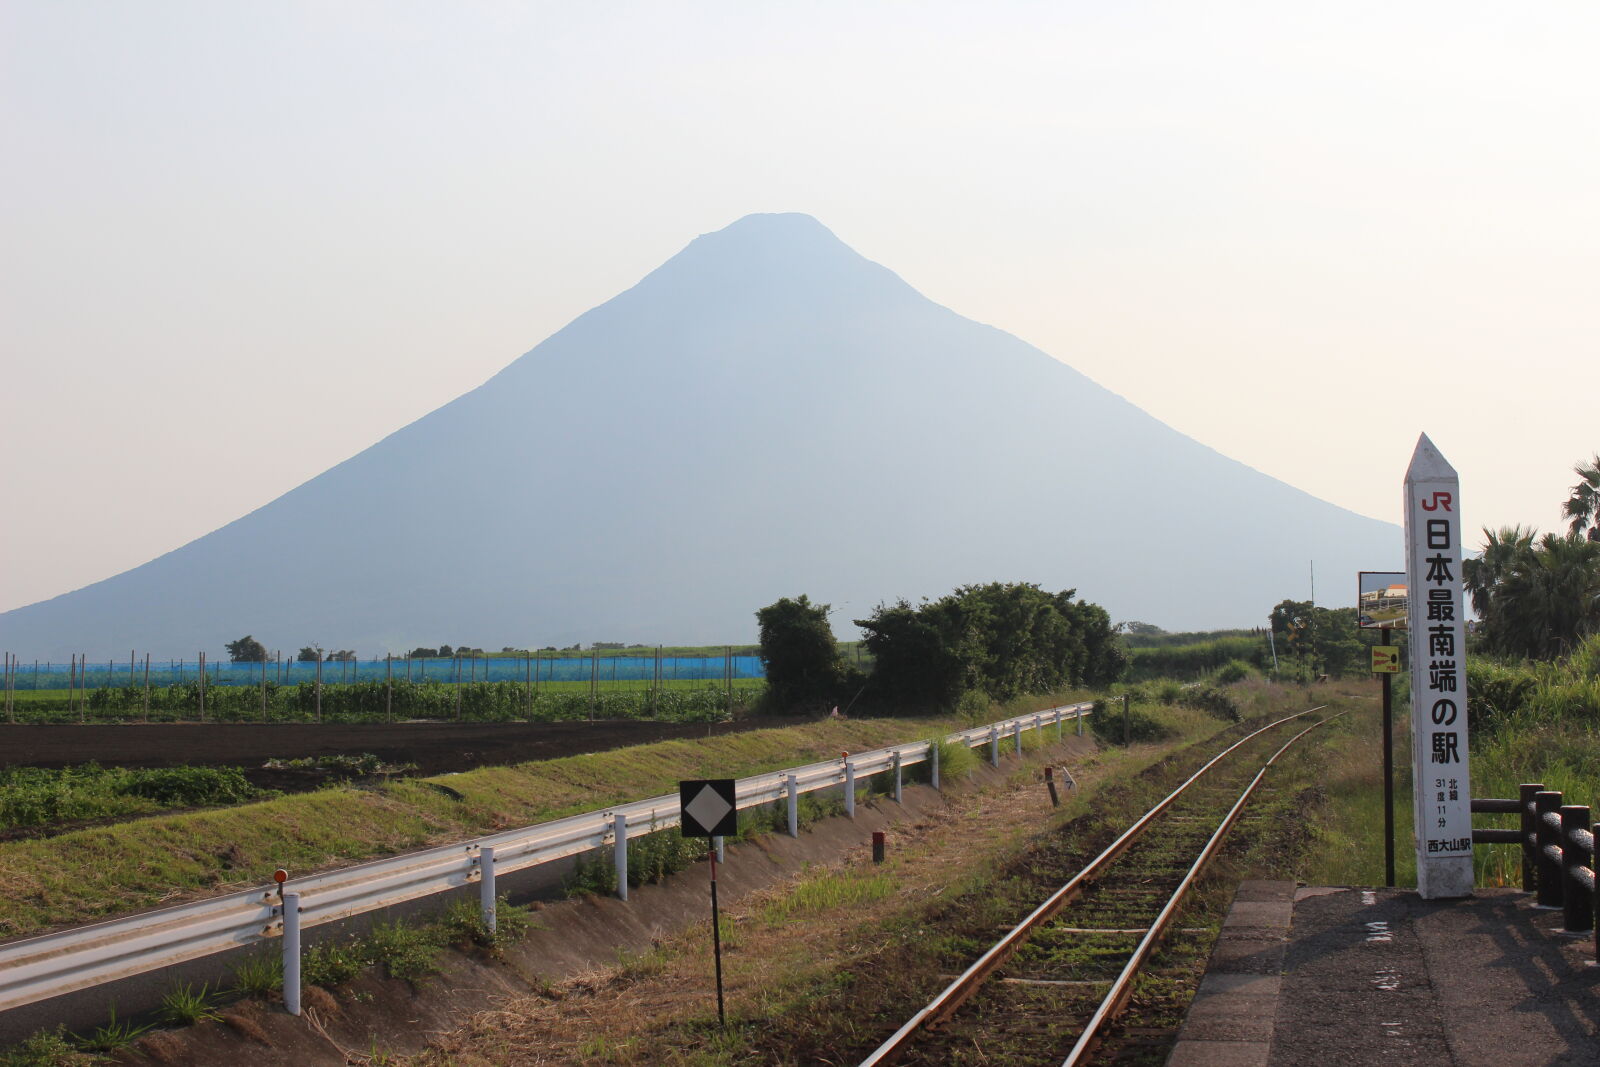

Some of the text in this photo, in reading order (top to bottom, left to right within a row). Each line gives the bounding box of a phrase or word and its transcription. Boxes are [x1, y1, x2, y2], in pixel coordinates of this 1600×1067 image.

[1422, 491, 1452, 512] JR
[1426, 519, 1460, 764] 日本最南端の駅
[1427, 838, 1471, 852] 西大山駅
